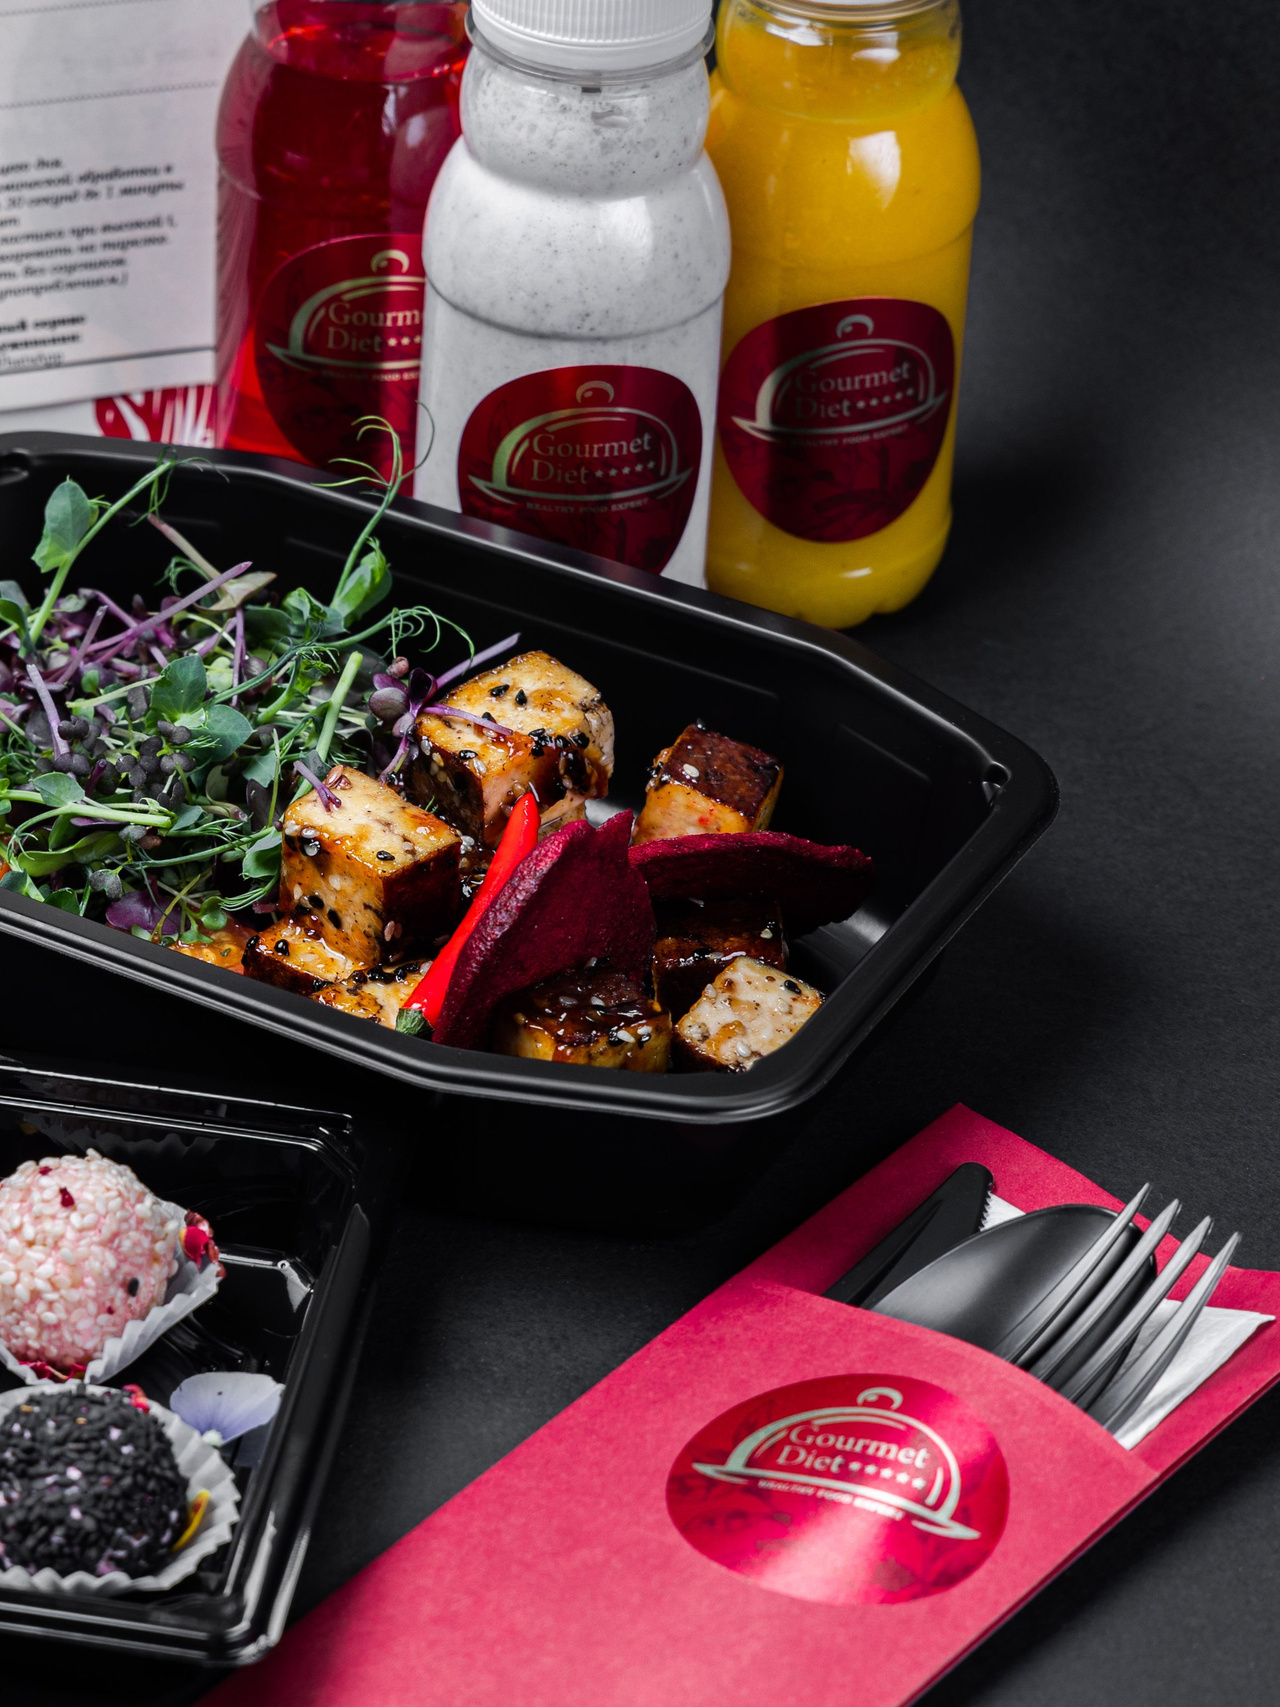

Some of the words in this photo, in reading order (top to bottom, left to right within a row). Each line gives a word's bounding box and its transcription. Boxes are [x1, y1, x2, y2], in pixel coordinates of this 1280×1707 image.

[328, 302, 421, 327] Gourm
[327, 327, 382, 353] Diet
[795, 361, 910, 394] Gourmet
[796, 397, 851, 418] Diet
[532, 432, 651, 459] Gourmet
[531, 459, 588, 484] Diet
[776, 1445, 845, 1474] Diet
[789, 1425, 930, 1469] Gourmet
